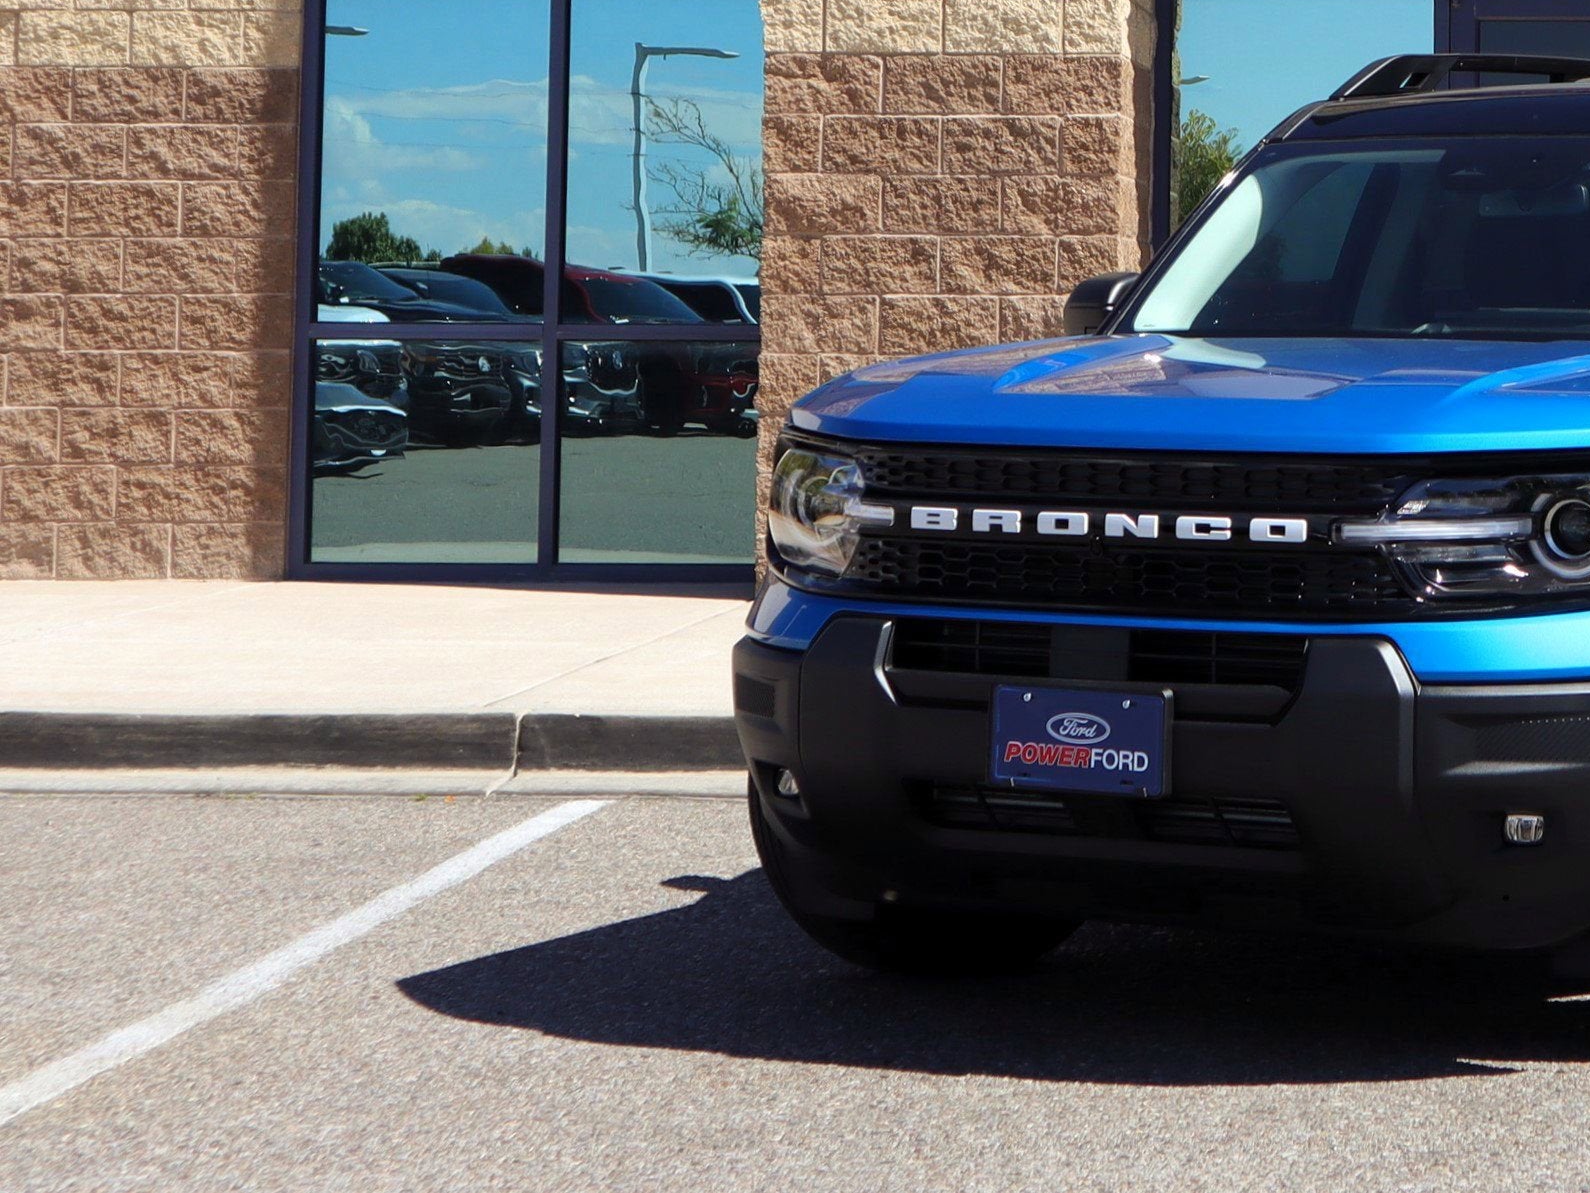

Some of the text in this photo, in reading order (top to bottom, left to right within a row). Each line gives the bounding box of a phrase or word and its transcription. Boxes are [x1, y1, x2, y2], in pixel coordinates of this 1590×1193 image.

[910, 505, 1308, 543] BRONCO
[1058, 717, 1098, 739] Ford
[1004, 740, 1149, 772] POWERFORD
